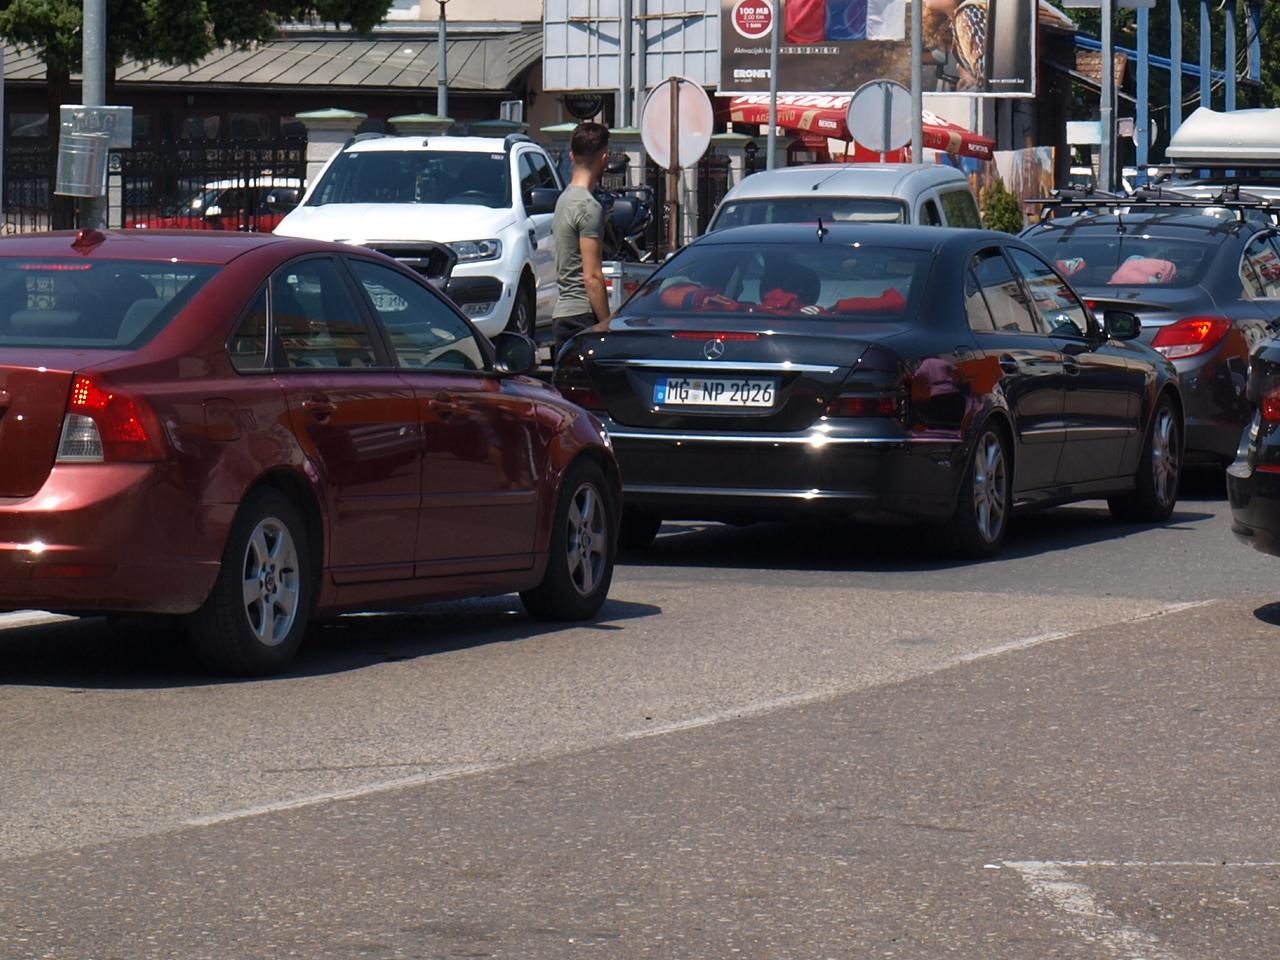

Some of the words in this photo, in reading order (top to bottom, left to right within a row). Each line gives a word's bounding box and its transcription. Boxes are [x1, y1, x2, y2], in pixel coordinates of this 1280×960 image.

[739, 7, 755, 15] 100
[756, 7, 769, 15] MB
[733, 69, 772, 78] ERONET
[751, 111, 771, 122] LAGE
[777, 110, 796, 121] PIVO
[667, 378, 690, 403] MG
[702, 380, 725, 402] NP
[730, 379, 773, 404] 2026
